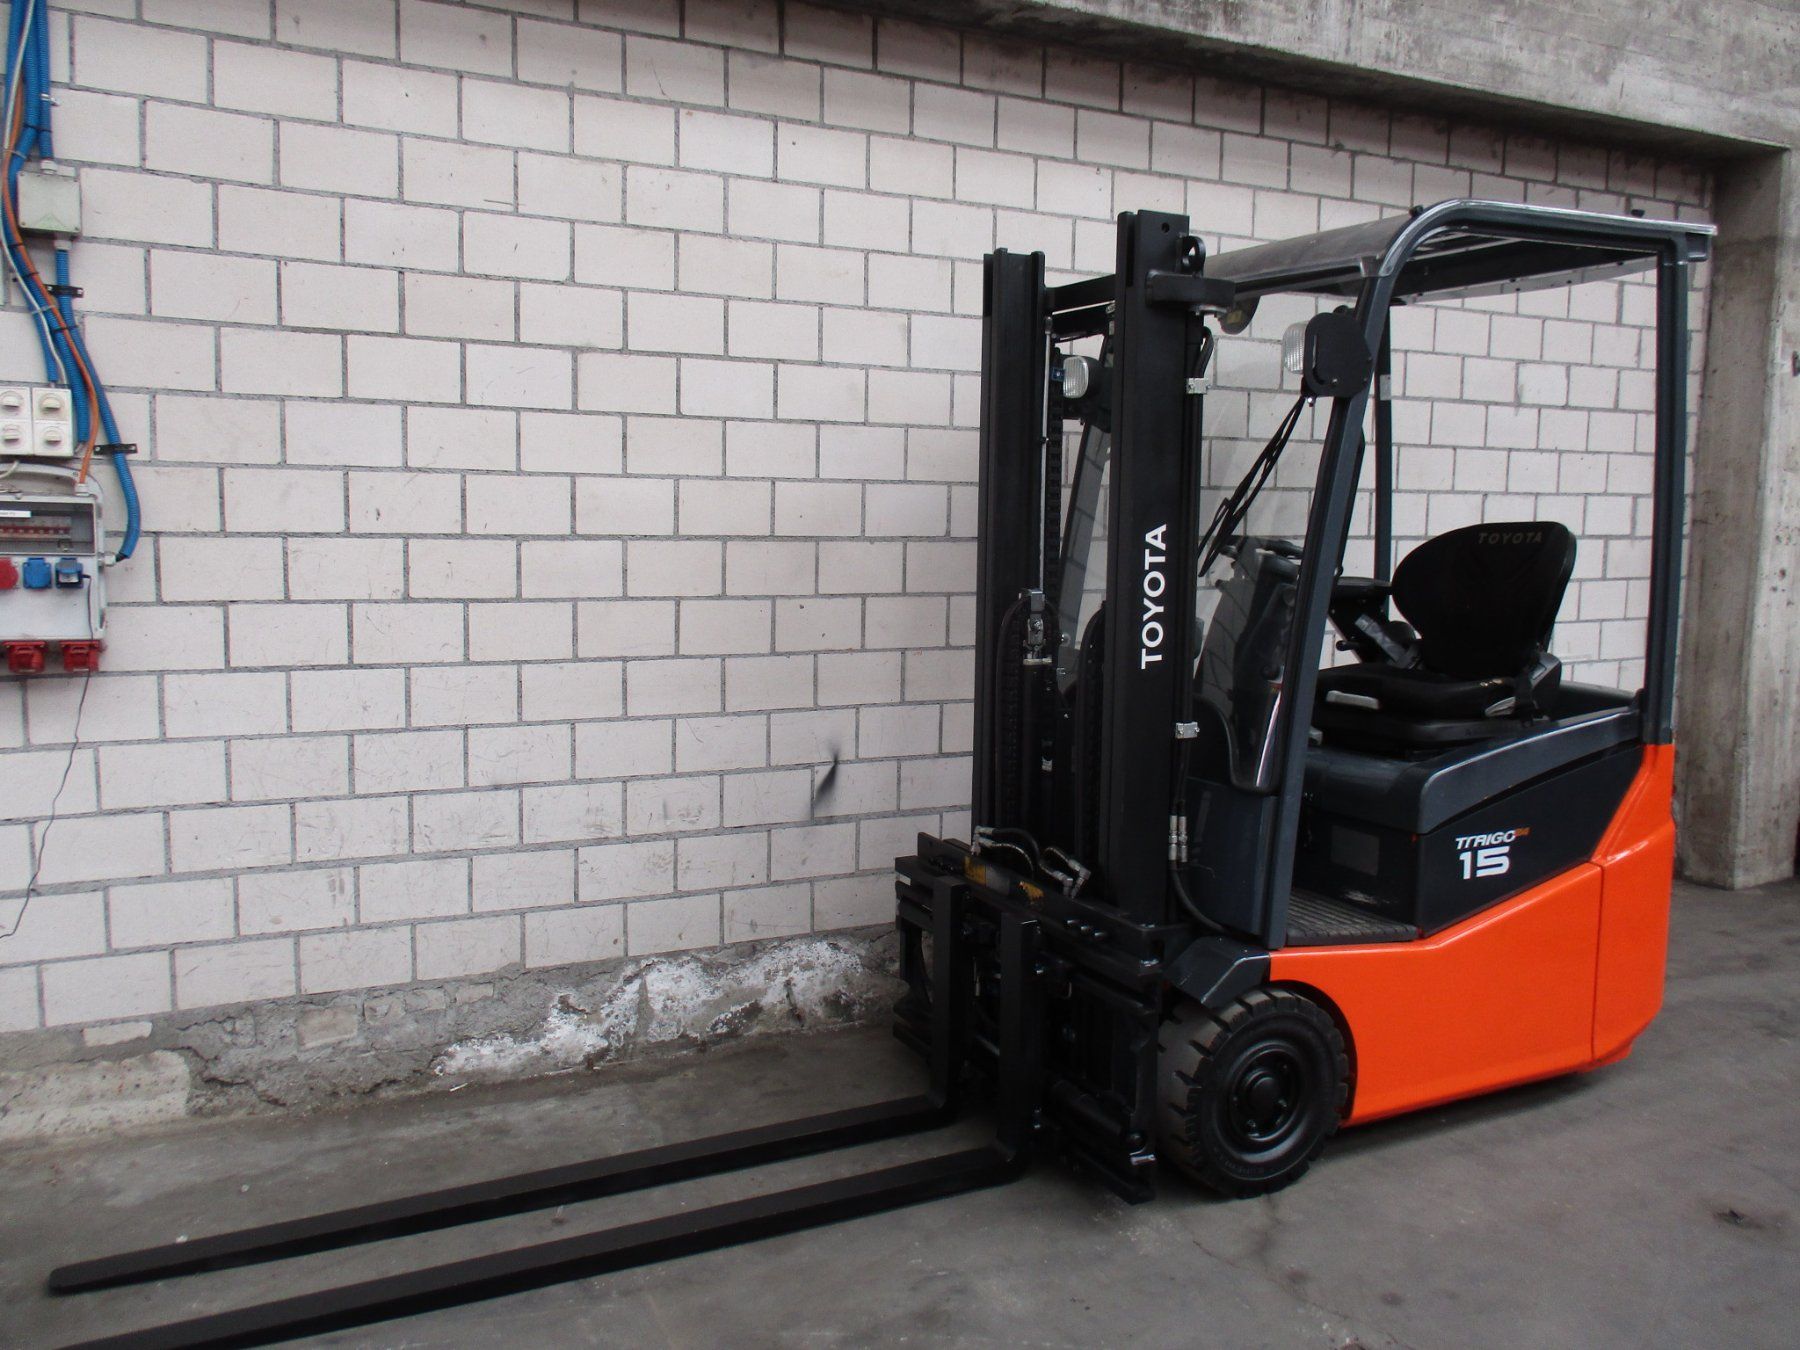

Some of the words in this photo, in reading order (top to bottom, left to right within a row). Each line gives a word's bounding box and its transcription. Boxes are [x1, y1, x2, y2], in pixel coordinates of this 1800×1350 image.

[1478, 532, 1543, 545] TOYOTA
[1141, 524, 1167, 669] TOYOTA
[1459, 846, 1510, 880] 15
